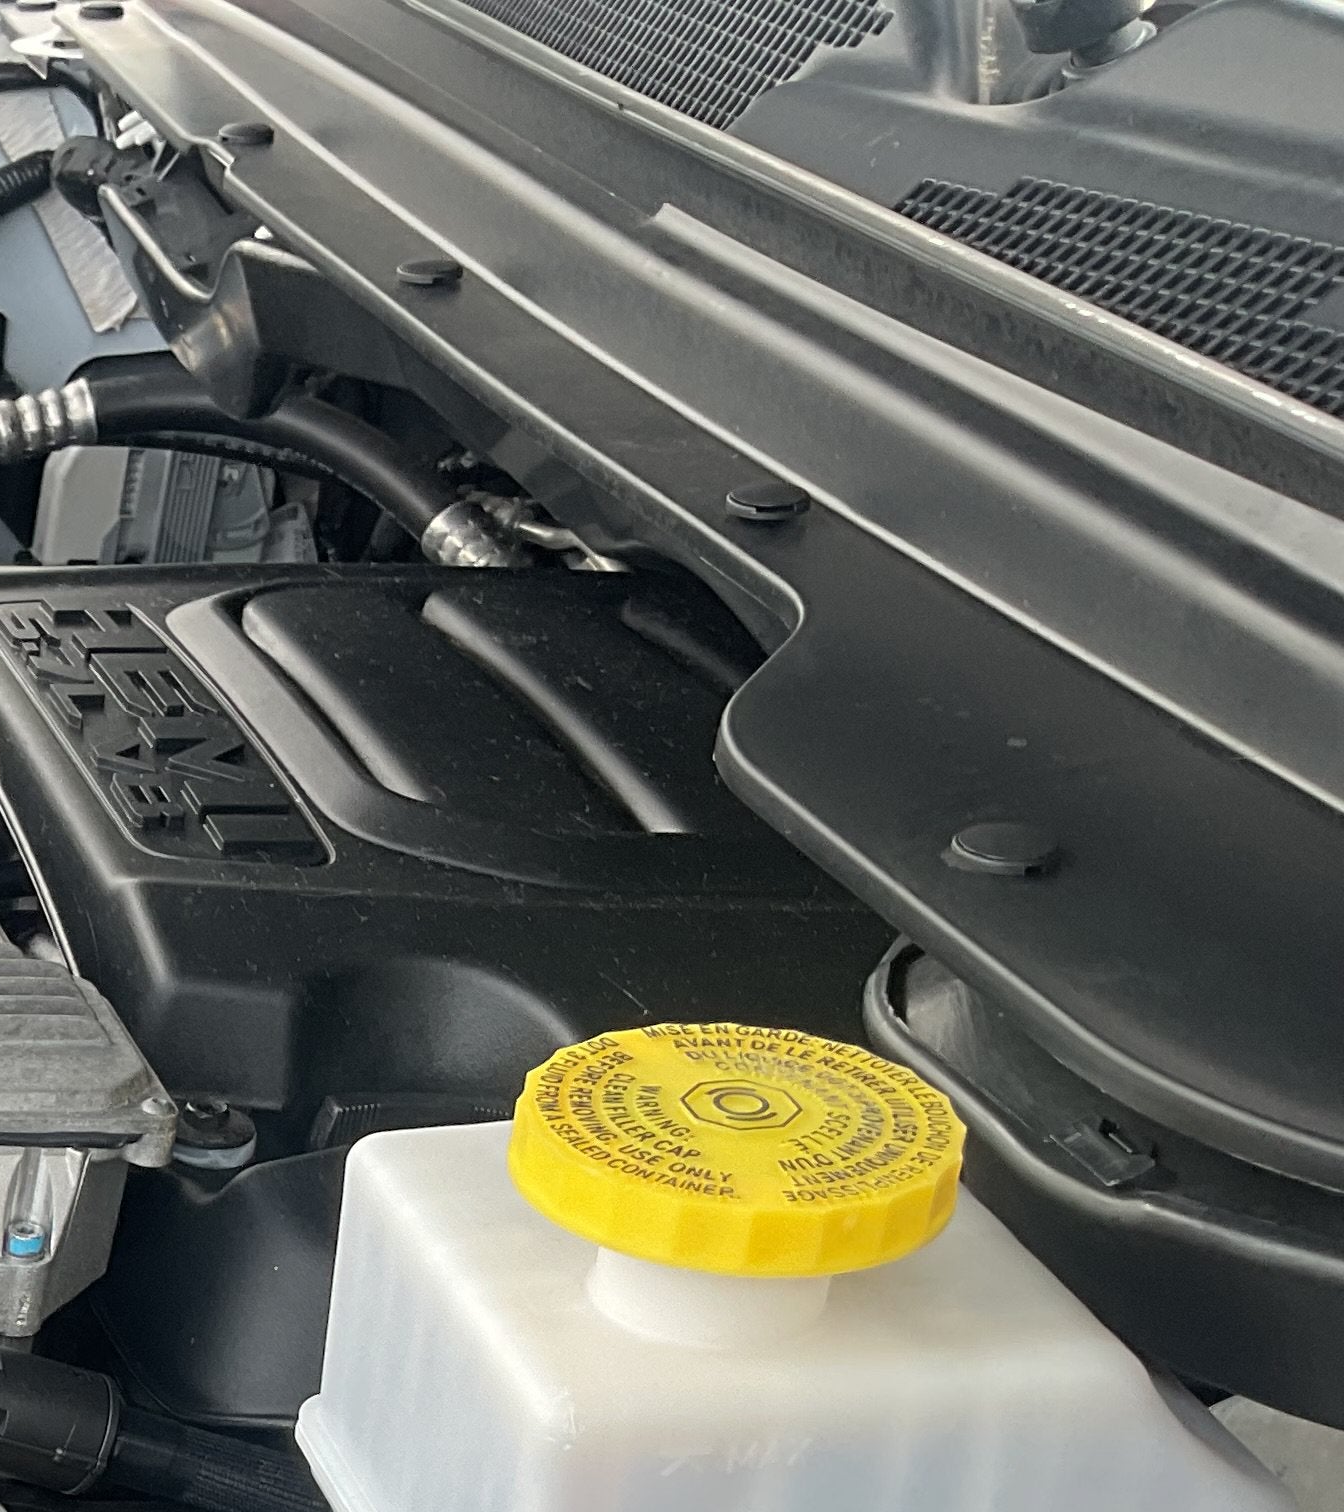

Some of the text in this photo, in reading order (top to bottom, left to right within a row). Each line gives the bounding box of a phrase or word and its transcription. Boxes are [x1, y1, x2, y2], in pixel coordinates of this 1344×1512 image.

[39, 600, 325, 854] HEMI
[90, 745, 184, 829] V8
[641, 1024, 694, 1038] MISE
[673, 1037, 746, 1049] AVANT
[700, 1024, 729, 1035] EN
[566, 1051, 586, 1061] 3
[579, 1037, 619, 1055] DOT
[750, 1040, 782, 1052] DE
[786, 1046, 817, 1060] LE
[540, 1058, 578, 1084] FLUID
[821, 1042, 918, 1086] NETTOYER
[536, 1083, 560, 1112] FROM
[908, 1087, 937, 1099] LE
[544, 1114, 566, 1122] A
[573, 1051, 634, 1086] BEFORE
[618, 1144, 663, 1166] USE
[668, 1162, 733, 1182] ONLY
[602, 1073, 701, 1159] CLEAN FILLER CAP
[636, 1085, 695, 1142] WARNING:
[685, 1051, 717, 1060] DU
[778, 1153, 834, 1171] D'UN
[920, 1101, 952, 1151] BOUCHON
[550, 1123, 611, 1161] SEALED
[792, 1143, 908, 1187] UNIQUEMENT
[725, 1438, 813, 1474] MAX
